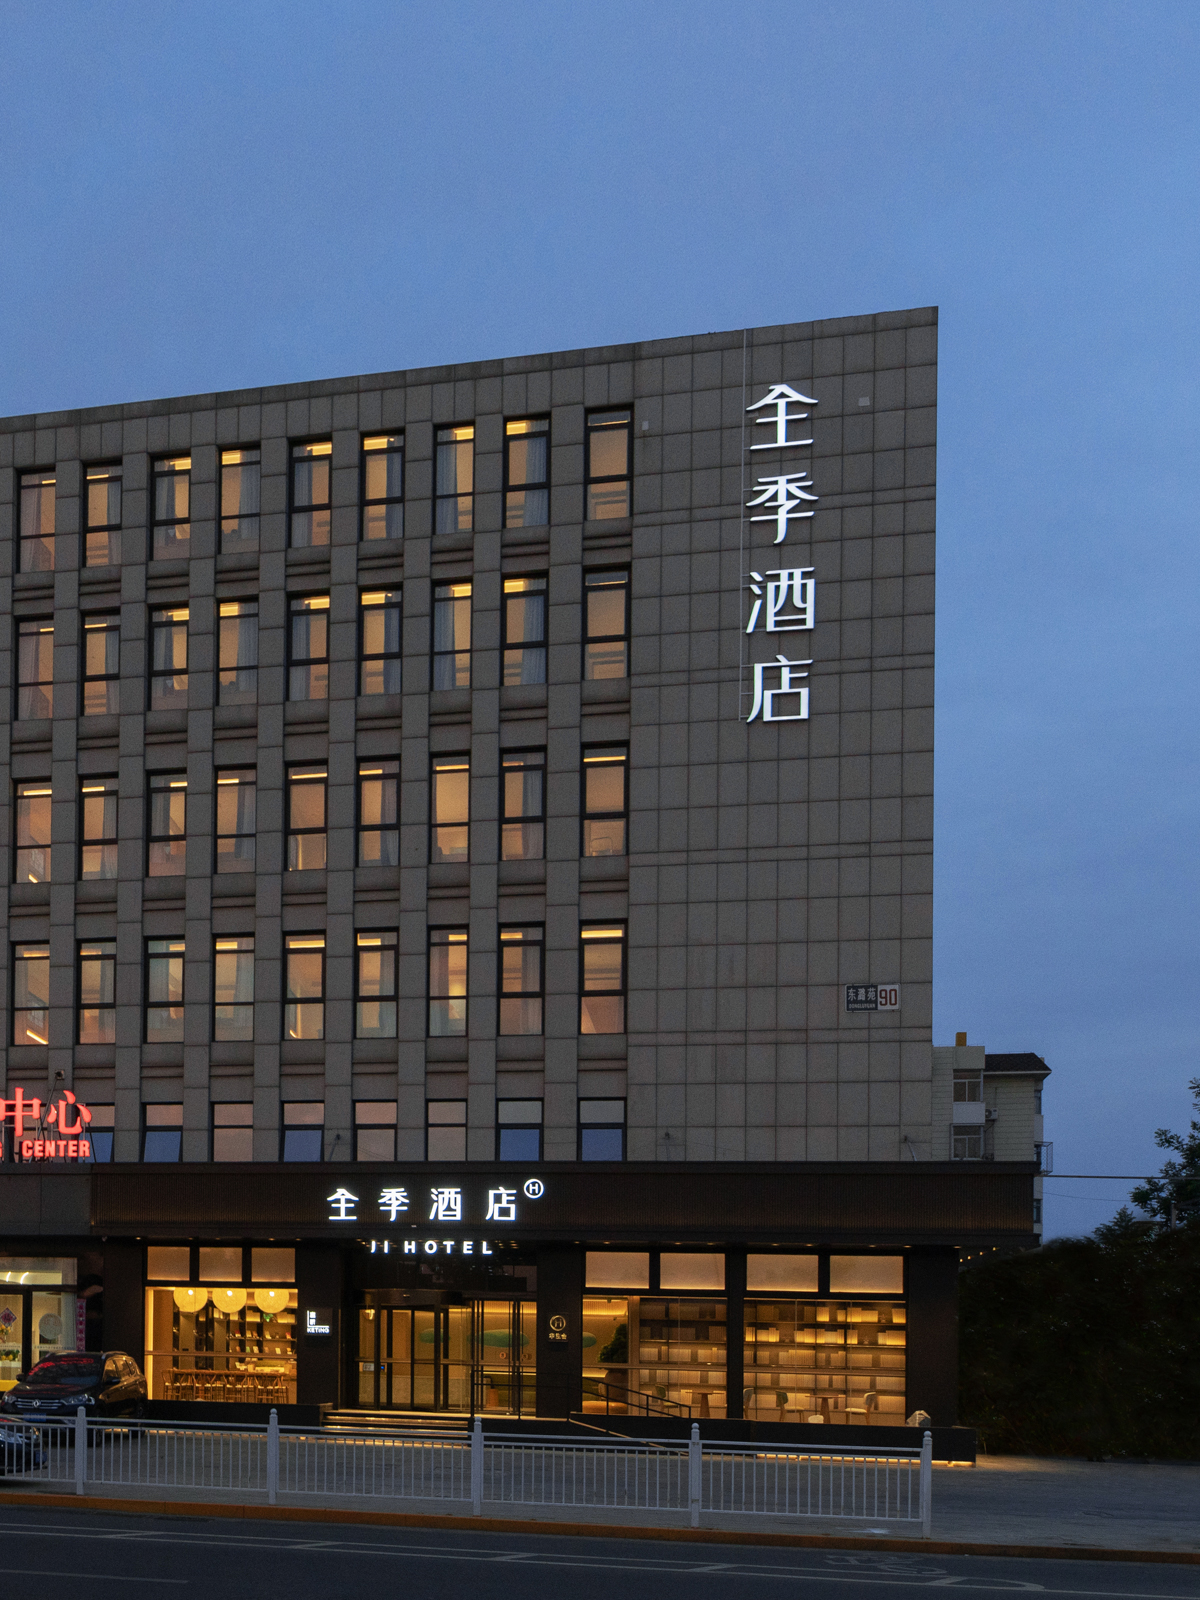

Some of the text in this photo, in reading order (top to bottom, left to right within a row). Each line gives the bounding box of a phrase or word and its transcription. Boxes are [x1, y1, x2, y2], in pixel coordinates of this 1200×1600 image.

[746, 383, 819, 723] 全季酒店
[879, 989, 897, 1006] 90
[21, 1140, 91, 1158] CENTER
[326, 1186, 518, 1222] 全季酒店
[370, 1240, 493, 1255] JI HOTEL
